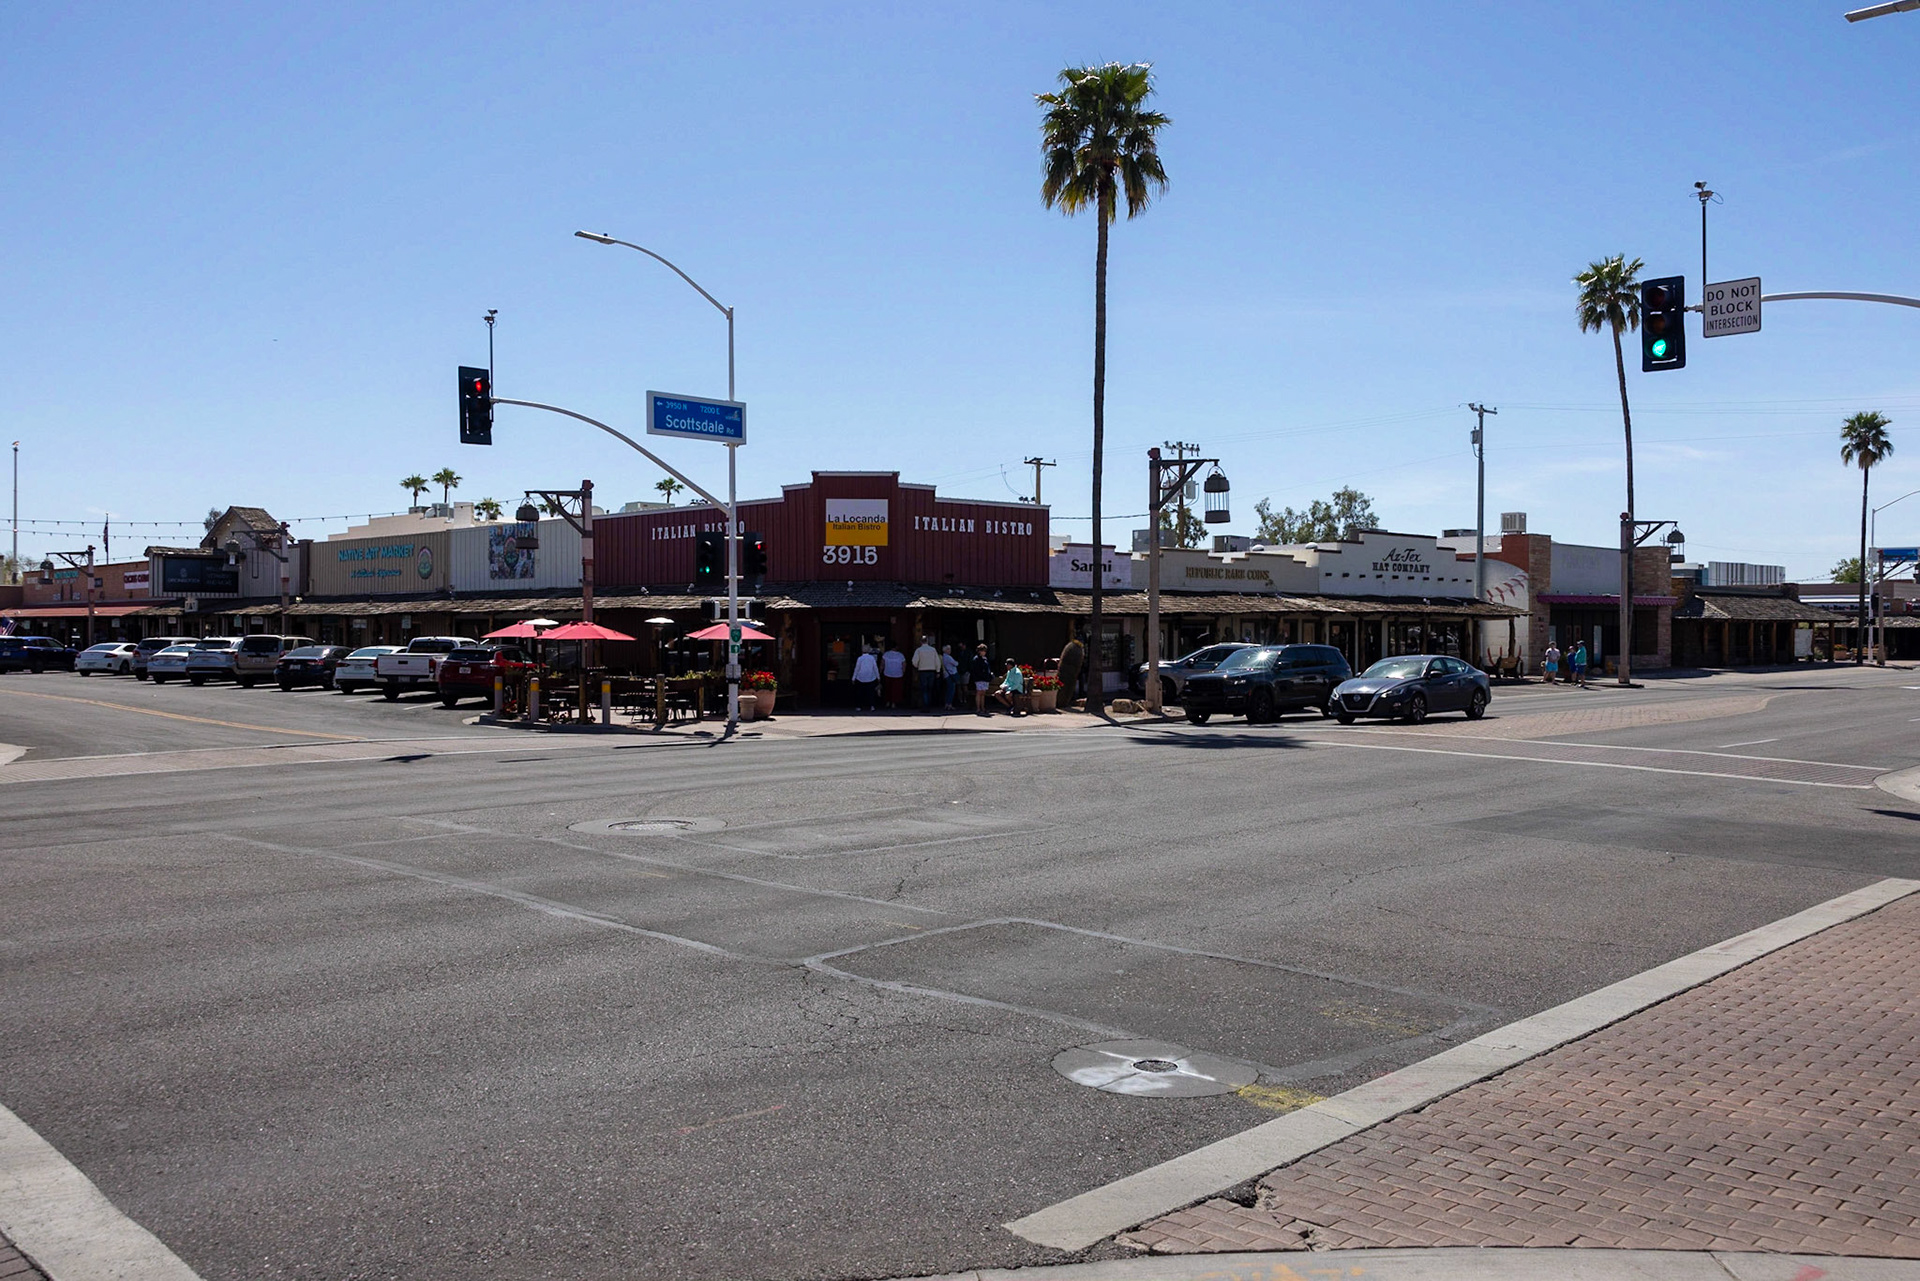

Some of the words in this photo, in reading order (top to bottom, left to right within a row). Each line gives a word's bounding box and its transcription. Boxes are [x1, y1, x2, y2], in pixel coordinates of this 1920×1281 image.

[1707, 290, 1725, 302] DO
[1731, 284, 1757, 298] NOT
[1711, 301, 1753, 316] BLOCK
[1706, 315, 1758, 331] INTERSECTION
[665, 401, 682, 411] 3950
[682, 403, 688, 411] N
[700, 405, 715, 415] 7200
[715, 407, 720, 415] E
[665, 415, 724, 434] Scottsdale
[726, 427, 734, 435] Rd
[828, 514, 840, 523] La
[843, 514, 886, 523] Locanda
[914, 516, 975, 533] ITALIAN
[986, 520, 1033, 536] BISTRO
[652, 524, 696, 541] ITALIAN
[704, 520, 745, 535] BISTO
[833, 523, 856, 531] Italian
[857, 523, 881, 531] Bistro
[338, 547, 363, 562] NATIVE
[365, 546, 380, 560] ART
[381, 543, 415, 558] MARKET
[823, 545, 878, 565] 3915
[1382, 547, 1422, 562] Az-Tex
[1186, 566, 1223, 579] REPUBLIC
[1225, 568, 1245, 580] RARE
[1247, 569, 1270, 581] COINS
[1372, 562, 1389, 572] HAT
[1392, 563, 1430, 573] COMPANY
